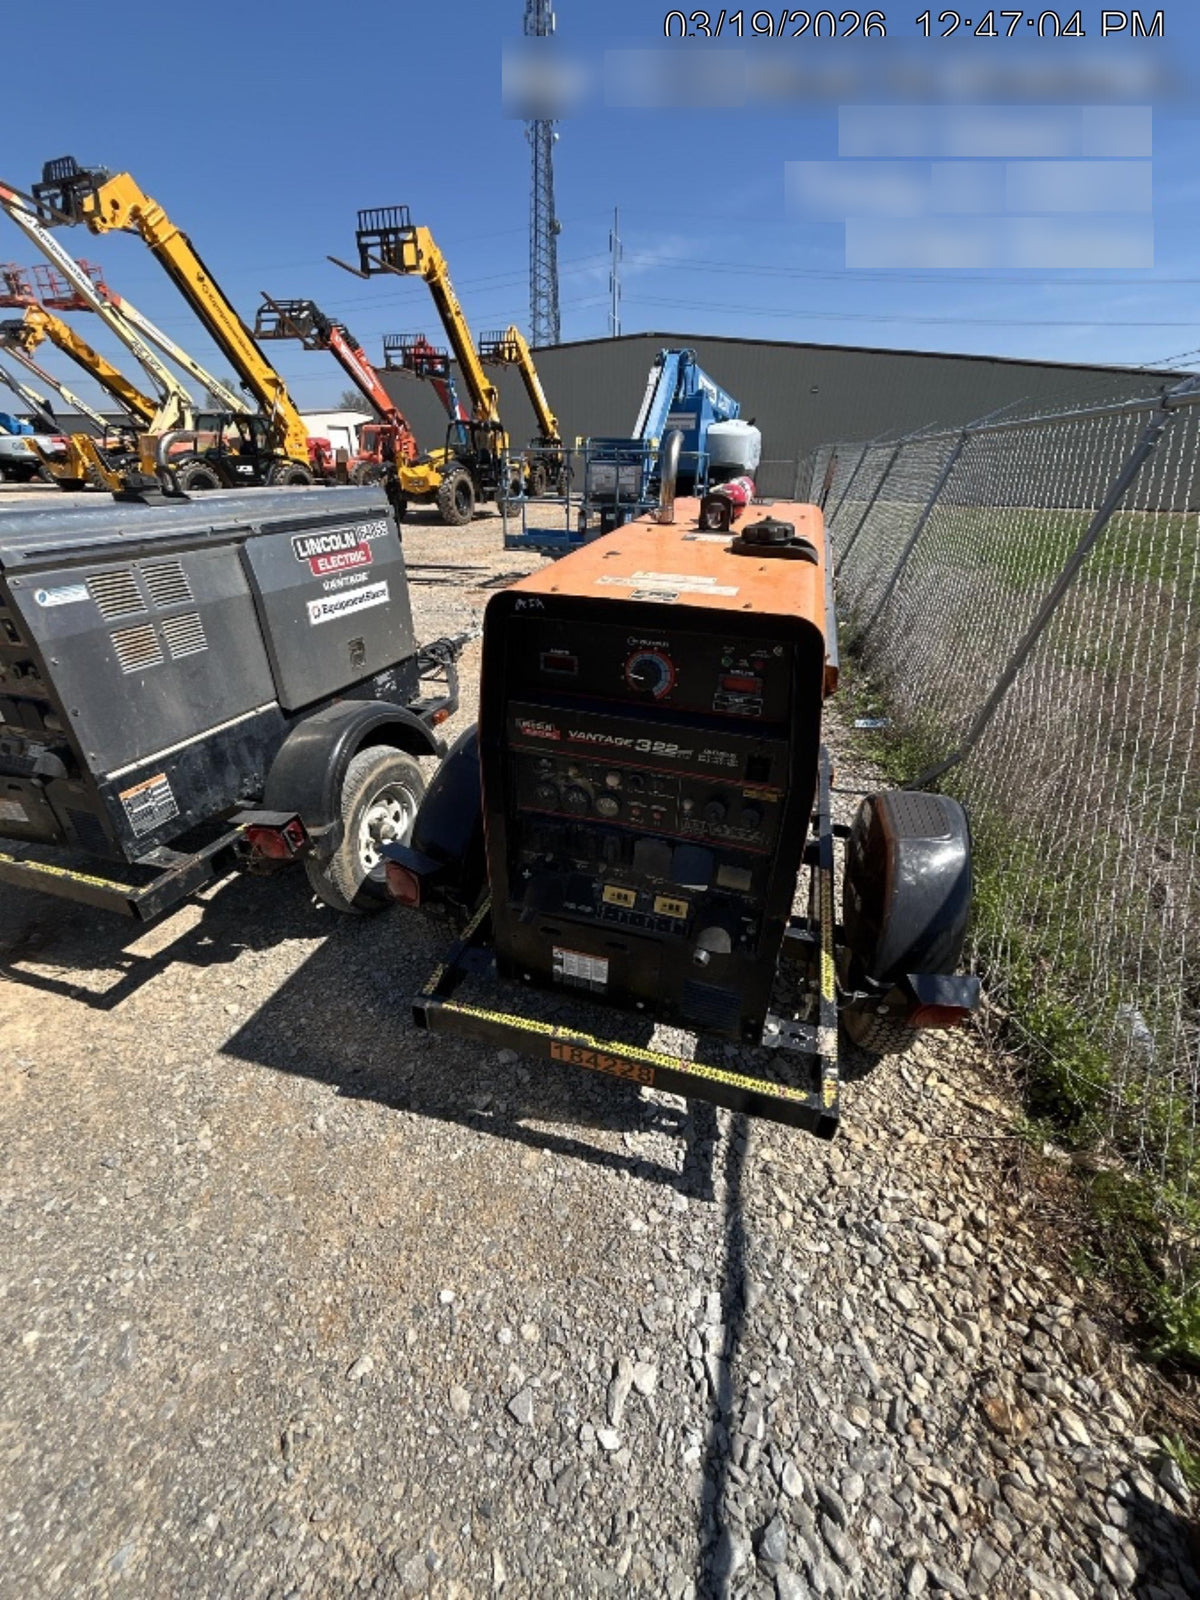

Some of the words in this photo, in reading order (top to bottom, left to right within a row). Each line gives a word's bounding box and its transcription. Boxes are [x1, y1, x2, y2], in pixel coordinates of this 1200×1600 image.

[297, 533, 355, 556] LINCOLN
[318, 551, 367, 570] ELECTRIC
[322, 573, 369, 591] VANTAGE
[567, 730, 634, 747] VANTAGE
[634, 738, 680, 755] 322
[553, 1044, 653, 1083] 184228
